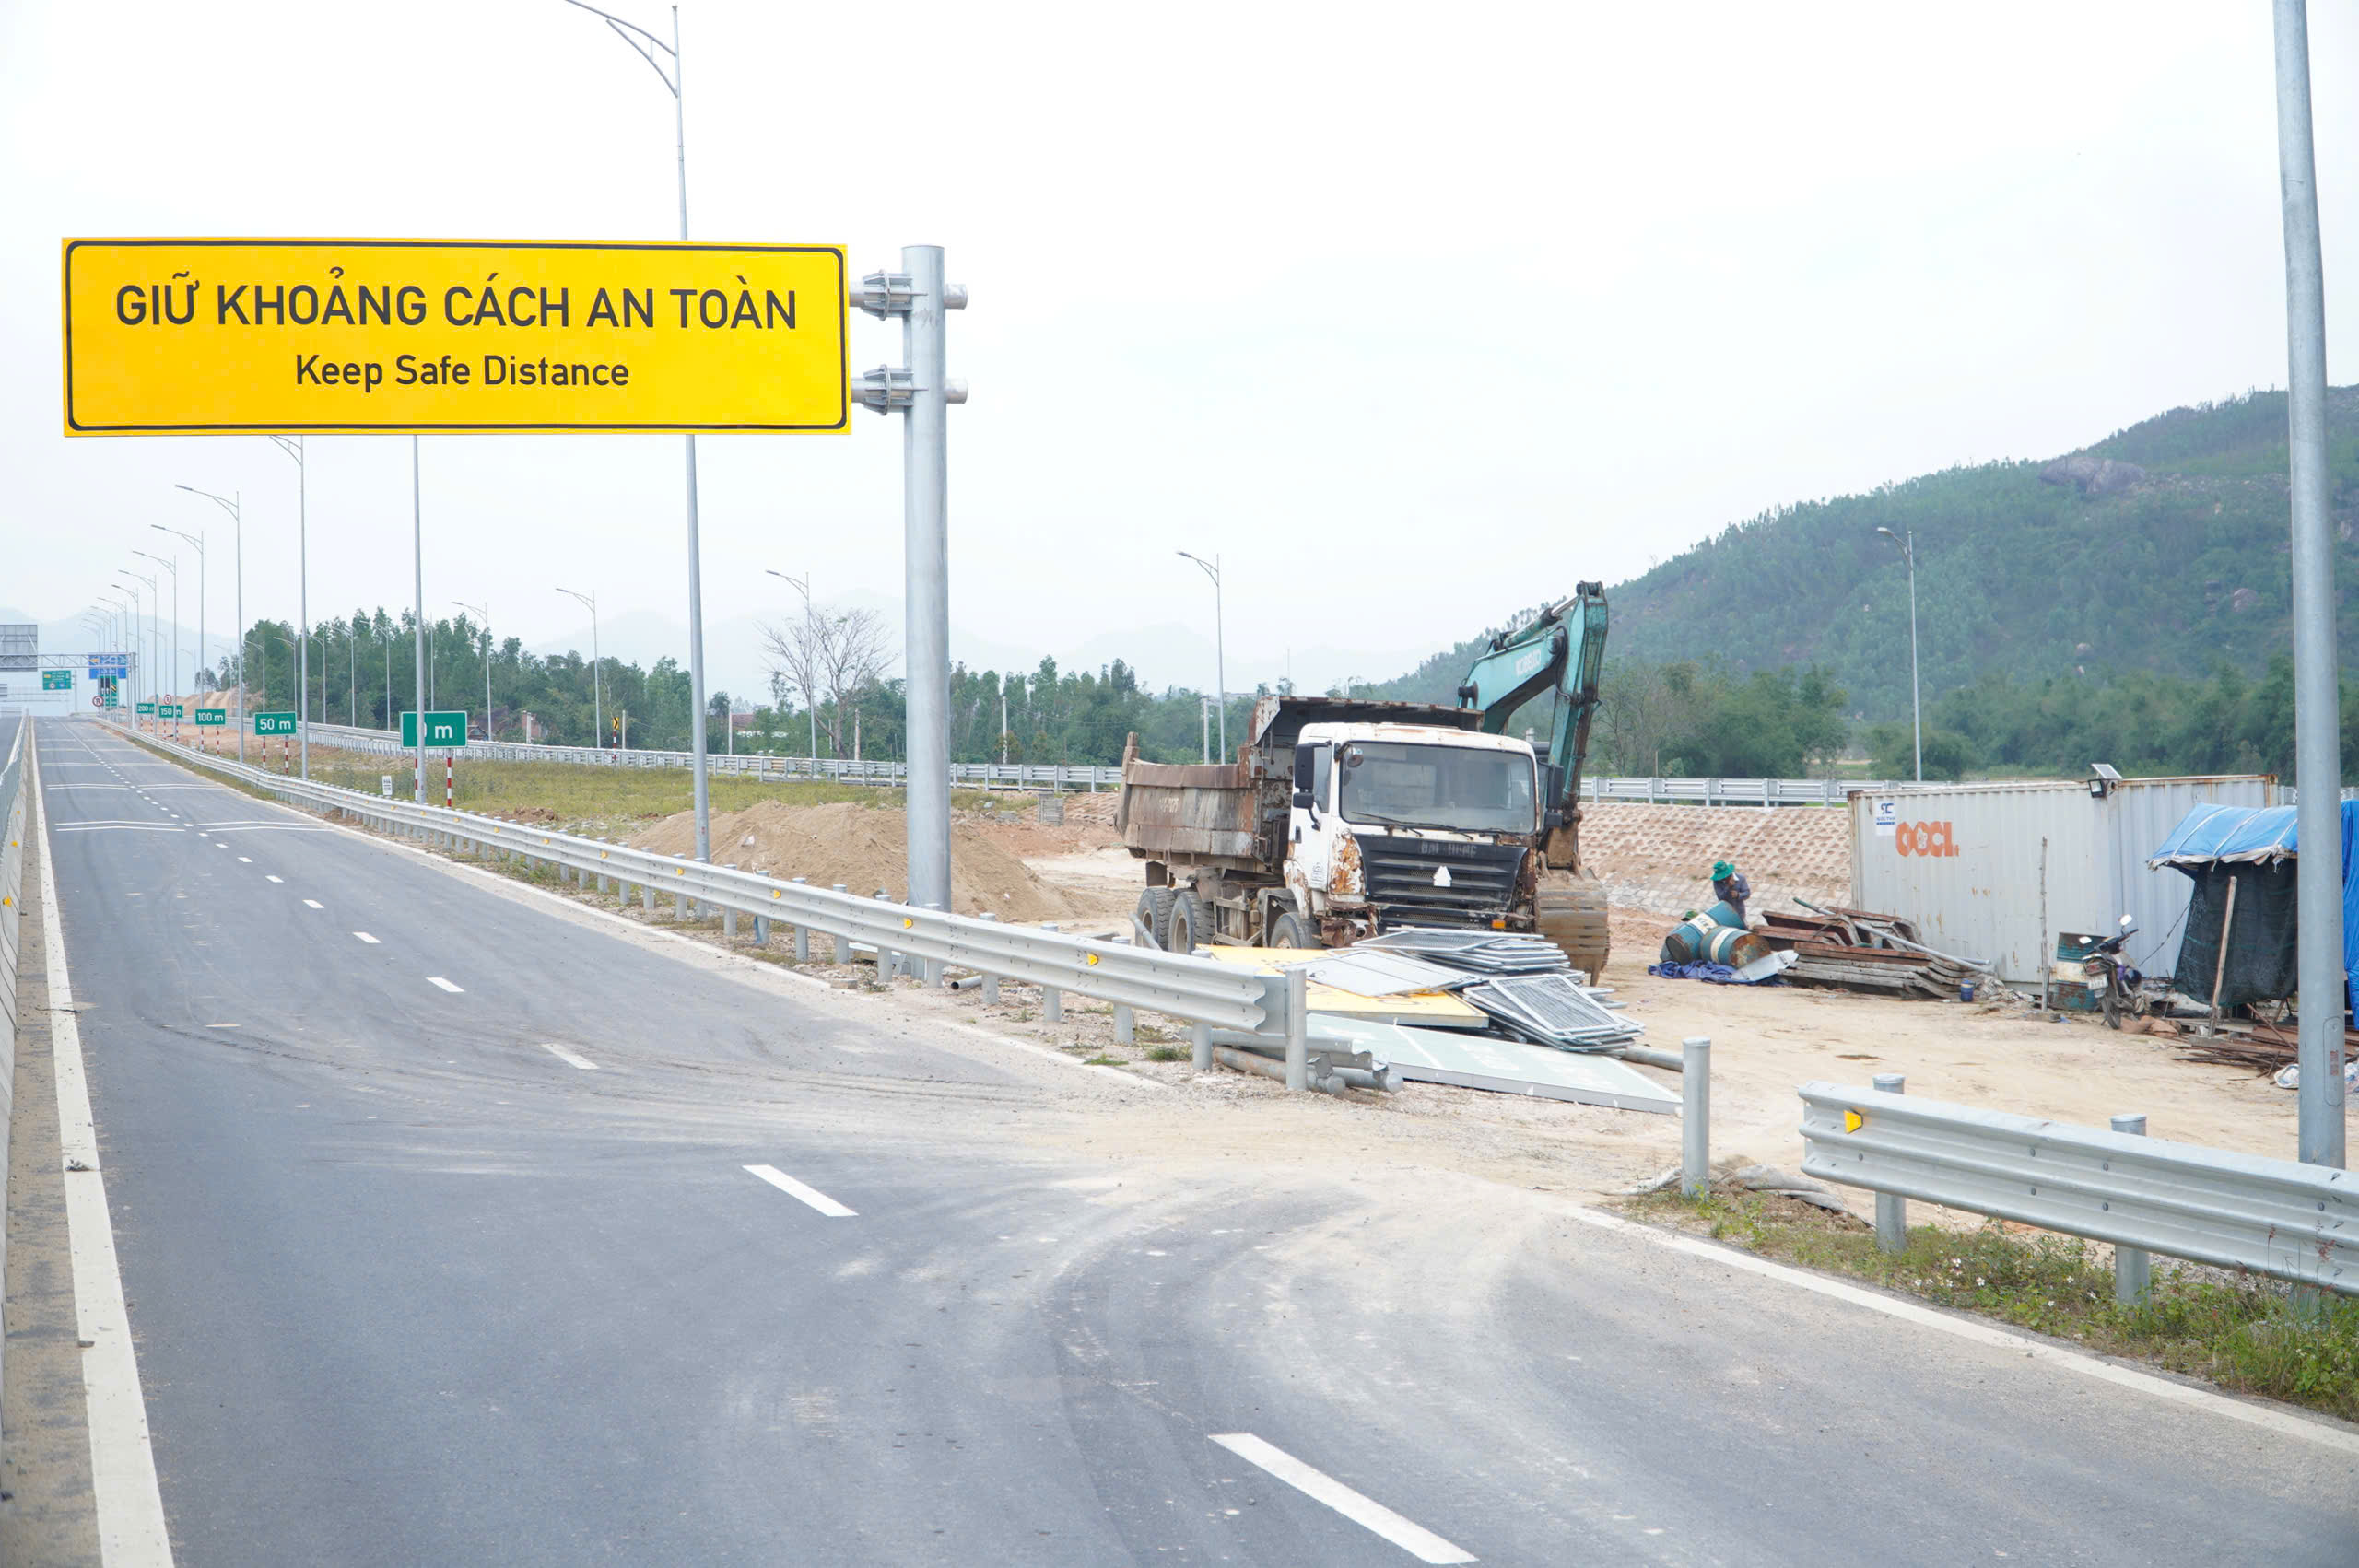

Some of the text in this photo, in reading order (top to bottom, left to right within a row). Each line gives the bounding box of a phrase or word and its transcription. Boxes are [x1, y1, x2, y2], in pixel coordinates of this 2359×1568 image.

[117, 267, 795, 329] GIỮ KHOẢNG CÁCH AN TOÀN
[297, 355, 628, 392] Keep Safe Distance
[160, 708, 172, 716] 150
[198, 712, 224, 722] 100 m
[259, 718, 291, 731] 50 m
[435, 725, 452, 739] m
[1896, 821, 1960, 857] OOCL
